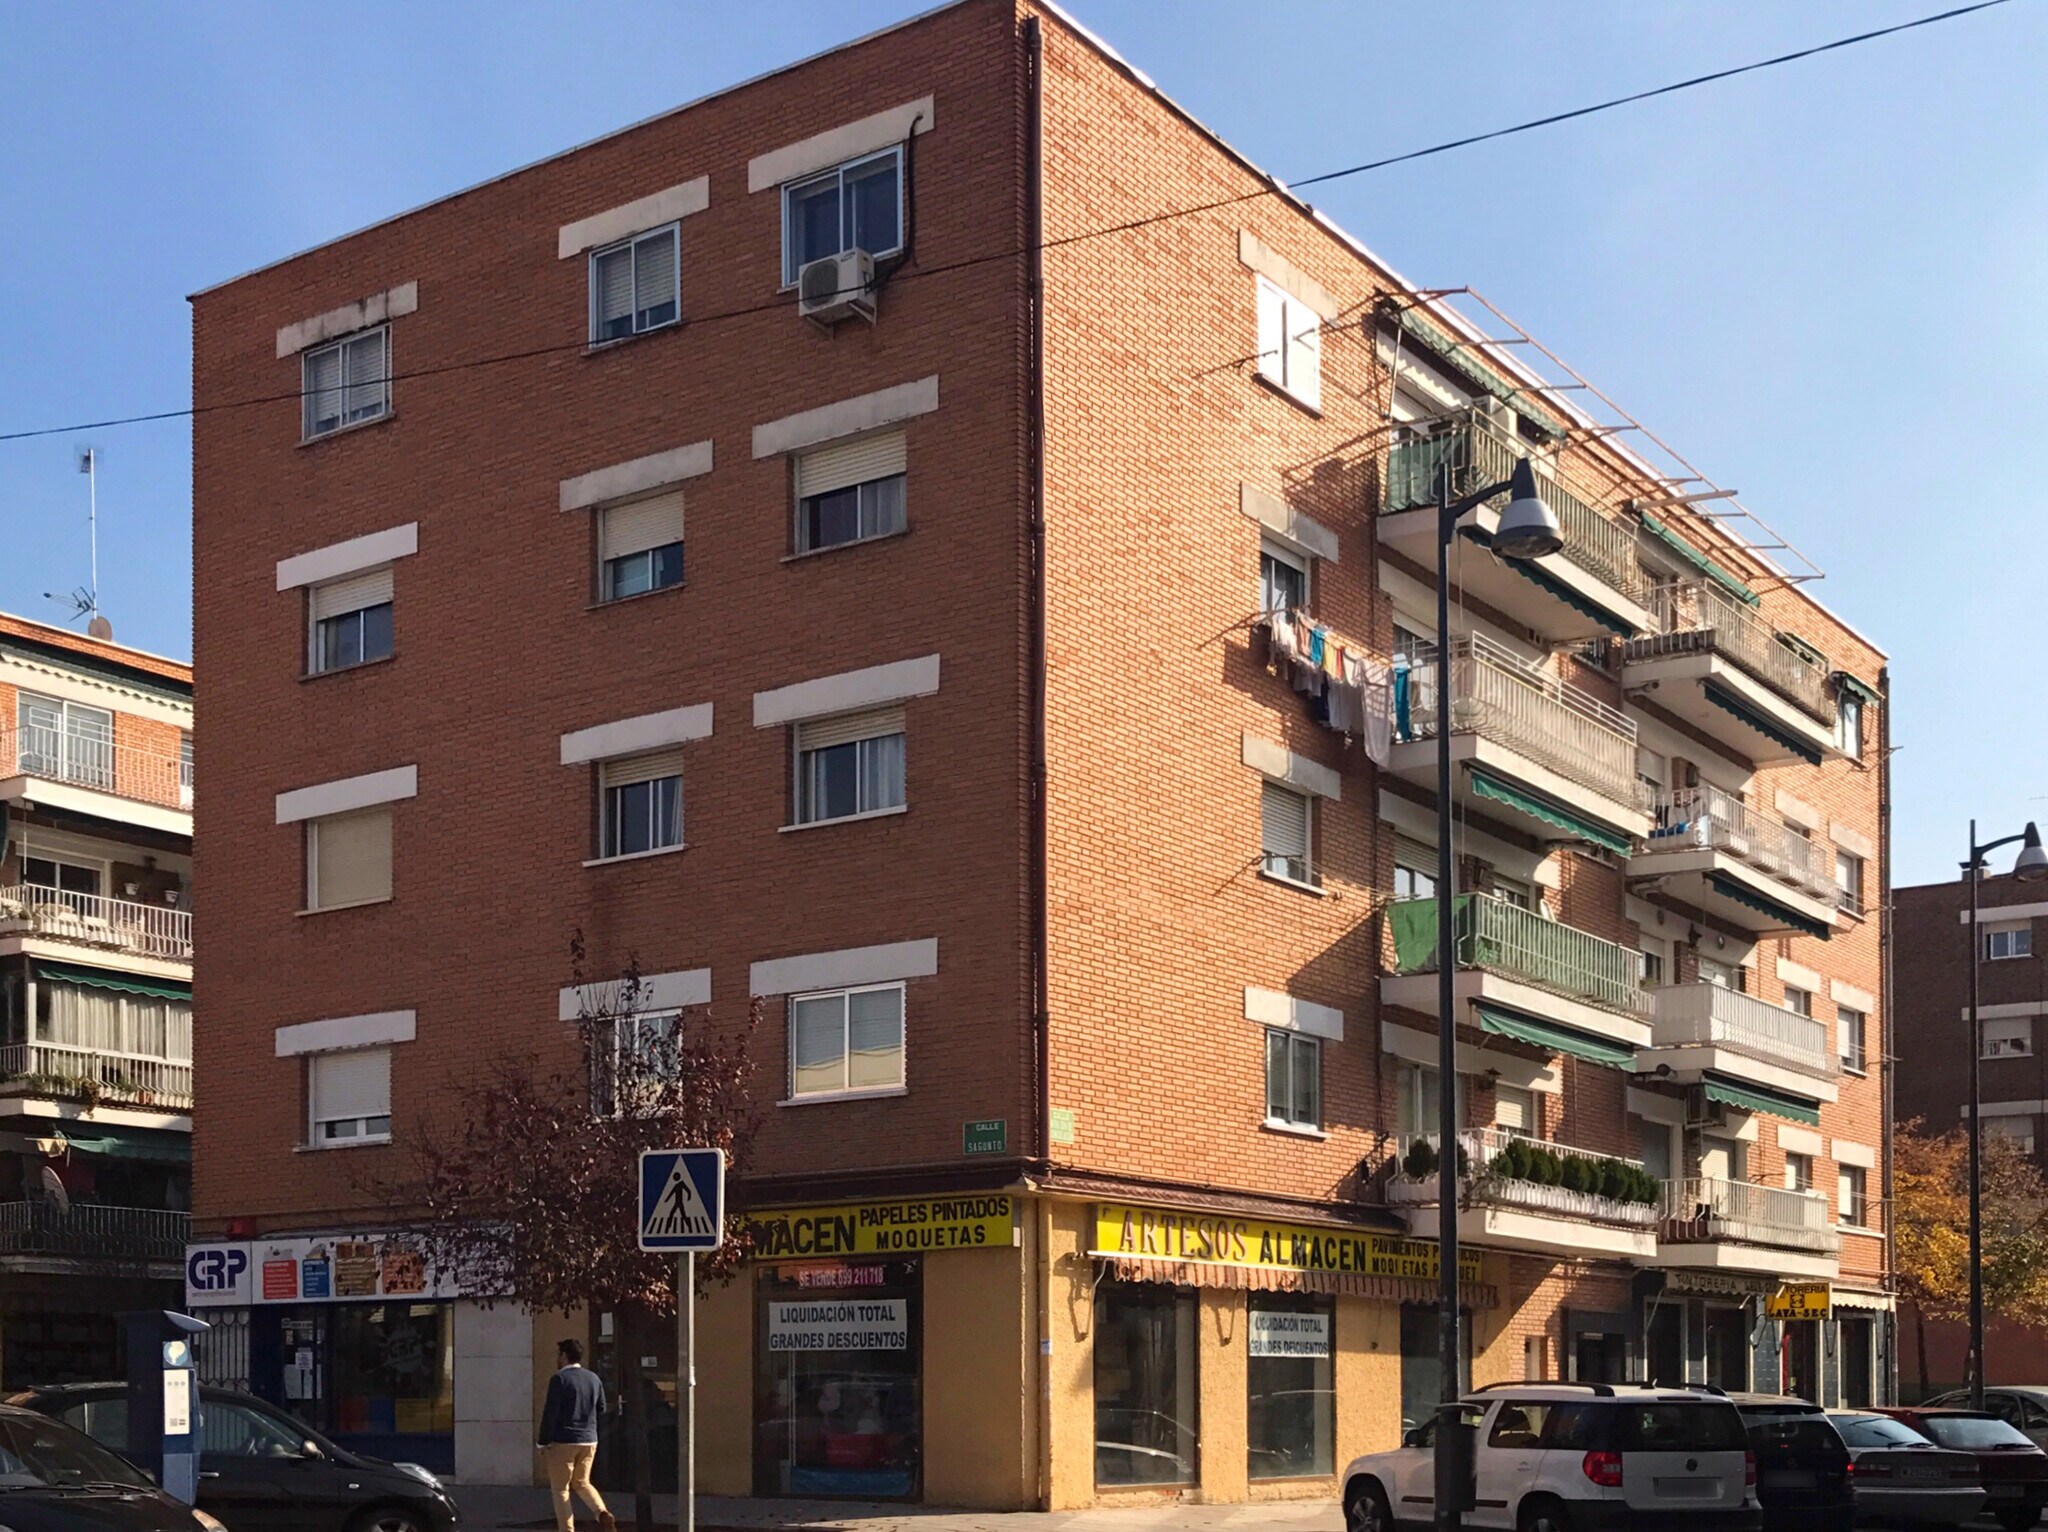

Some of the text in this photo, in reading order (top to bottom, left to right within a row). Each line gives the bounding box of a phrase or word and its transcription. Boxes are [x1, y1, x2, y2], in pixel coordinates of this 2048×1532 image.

[976, 1122, 999, 1131] CALLE
[968, 1141, 1002, 1152] SAGUNTO
[860, 1196, 1009, 1227] PAPELES PINTADOS
[751, 1215, 856, 1256] MACEN
[876, 1225, 986, 1250] MOQUETAS
[1119, 1210, 1248, 1261] ARTESOS
[1259, 1230, 1366, 1272] ALMACEN
[188, 1249, 247, 1290] CRP
[798, 1271, 810, 1287] SE
[811, 1270, 836, 1287] VENDE
[1785, 1286, 1827, 1295] TORERIA
[780, 1303, 896, 1323] LIQUIDACIÓN TOTAL
[1300, 1318, 1323, 1333] TOTAL
[770, 1331, 906, 1350] GRANDES DESCUENTOS
